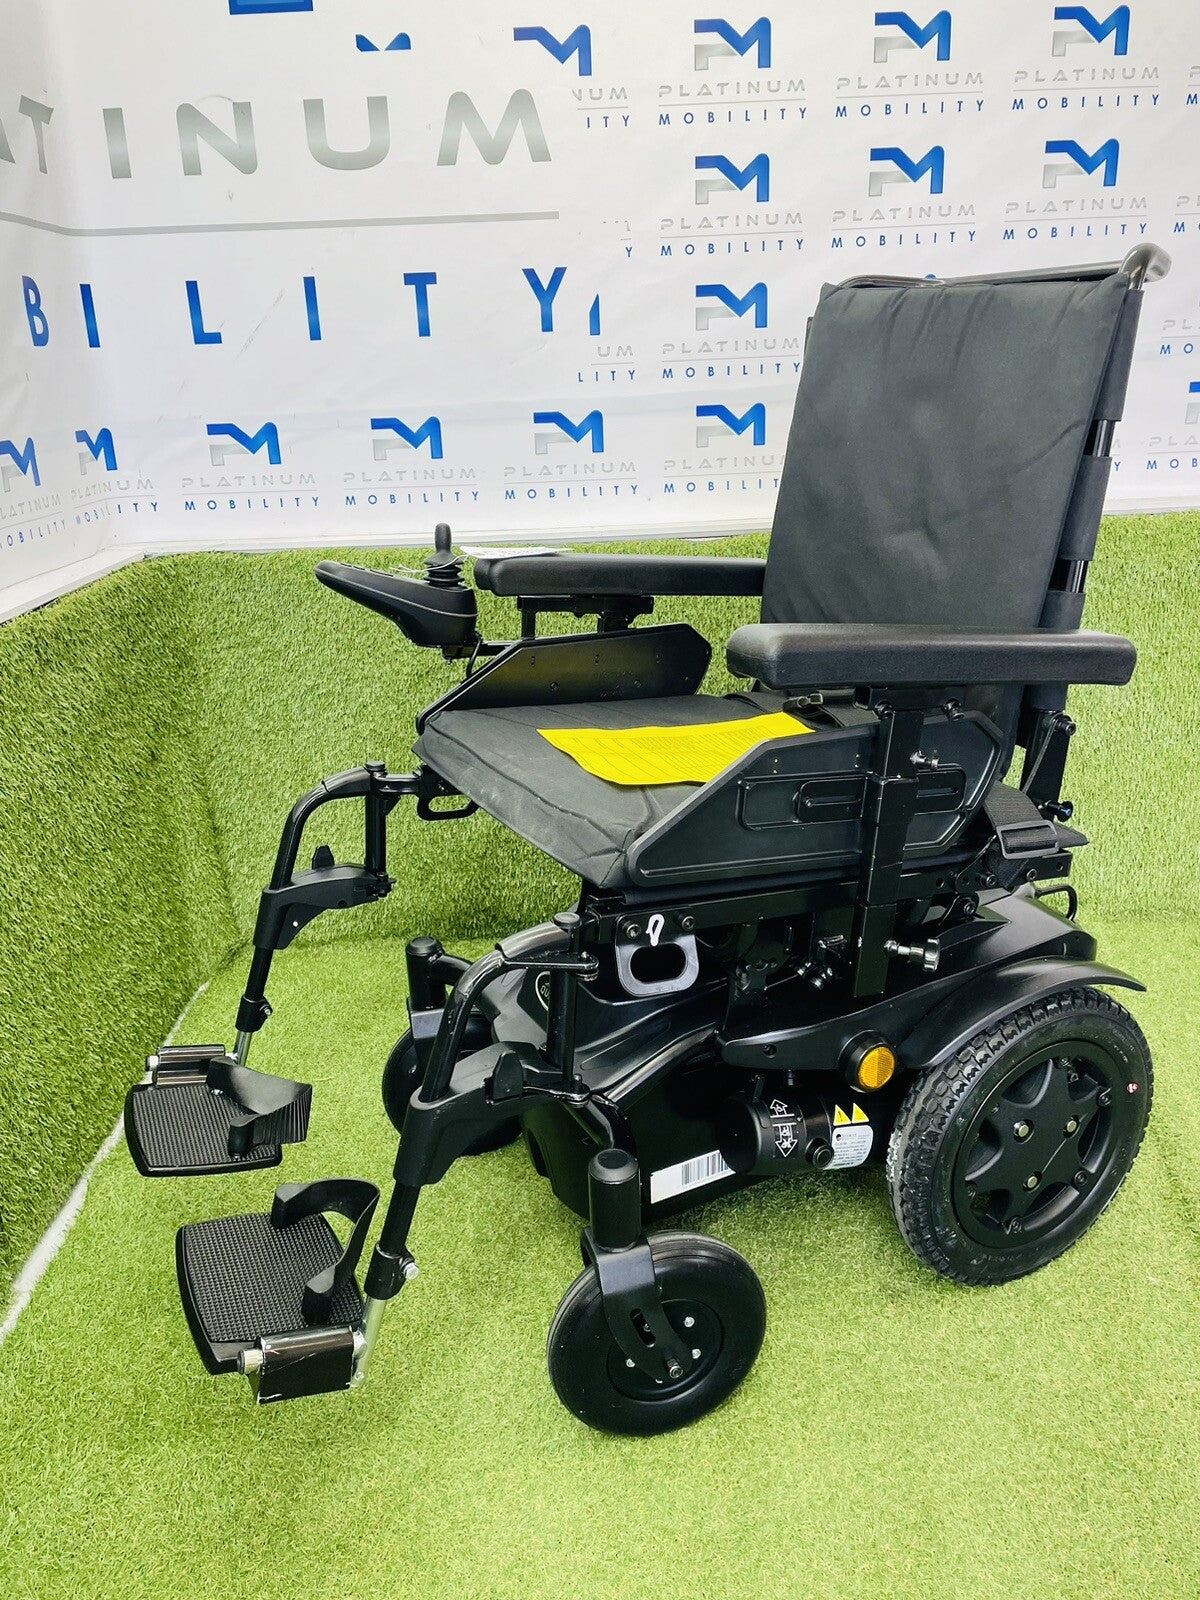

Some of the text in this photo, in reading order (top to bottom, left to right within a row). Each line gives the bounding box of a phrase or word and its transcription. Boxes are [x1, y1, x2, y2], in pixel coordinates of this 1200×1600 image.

[836, 72, 984, 90] PLATINUM
[1014, 67, 1160, 83] PLATINUM
[659, 79, 806, 97] PLATINUM
[836, 100, 984, 118] MOBILITY
[1012, 94, 1160, 111] MOBILITY
[659, 107, 807, 126] MOBILITY
[832, 204, 976, 222] PLATINUM
[1005, 197, 1147, 214] PLATINUM
[660, 213, 803, 230] PLATINUM
[832, 231, 976, 248] MOBILITY
[1003, 223, 1147, 240] MOBILITY
[660, 239, 804, 256] MOBILITY
[662, 338, 799, 354] PLATINUM
[662, 362, 800, 379] MOBILITY
[343, 468, 476, 482] PLATINUM
[504, 461, 637, 477] PLATINUM
[182, 473, 316, 488] PLATINUM
[345, 491, 479, 506] MOBILITY
[505, 485, 638, 500] MOBILITY
[185, 497, 319, 511] MOBILITY
